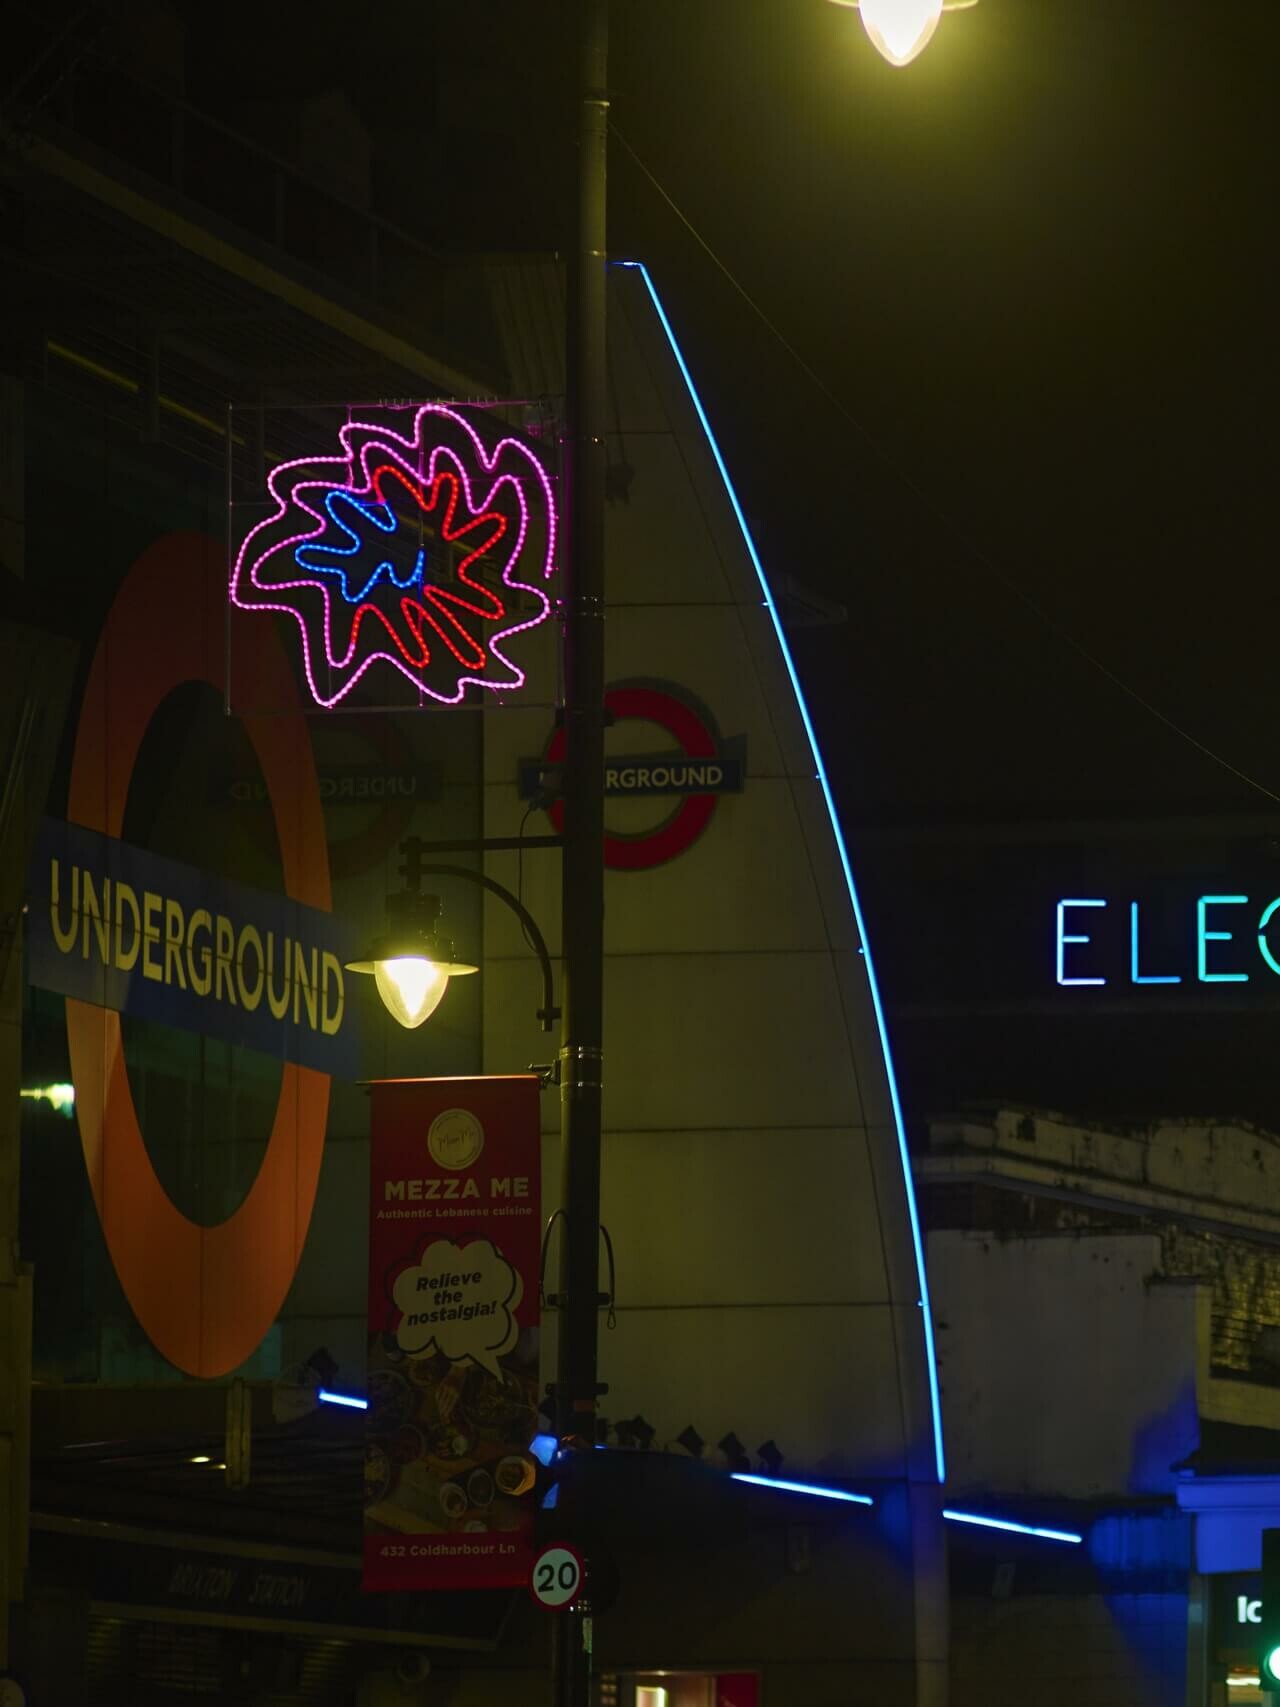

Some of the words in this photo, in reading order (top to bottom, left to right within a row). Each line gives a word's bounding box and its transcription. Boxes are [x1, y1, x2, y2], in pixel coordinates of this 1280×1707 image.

[605, 765, 723, 790] RGROUND
[50, 858, 345, 1036] UNDERGROUND
[384, 1178, 481, 1201] MEZZA
[490, 1176, 529, 1198] ME
[376, 1208, 433, 1220] Authentic
[435, 1207, 489, 1218] Lebanese
[492, 1206, 533, 1216] cuisine
[416, 1271, 482, 1292] Relieve
[434, 1290, 463, 1305] the
[407, 1301, 498, 1326] nostalgia!
[380, 1545, 406, 1557] 432
[410, 1544, 496, 1556] Coldharbour
[499, 1543, 516, 1553] Ln
[537, 1561, 577, 1593] 20
